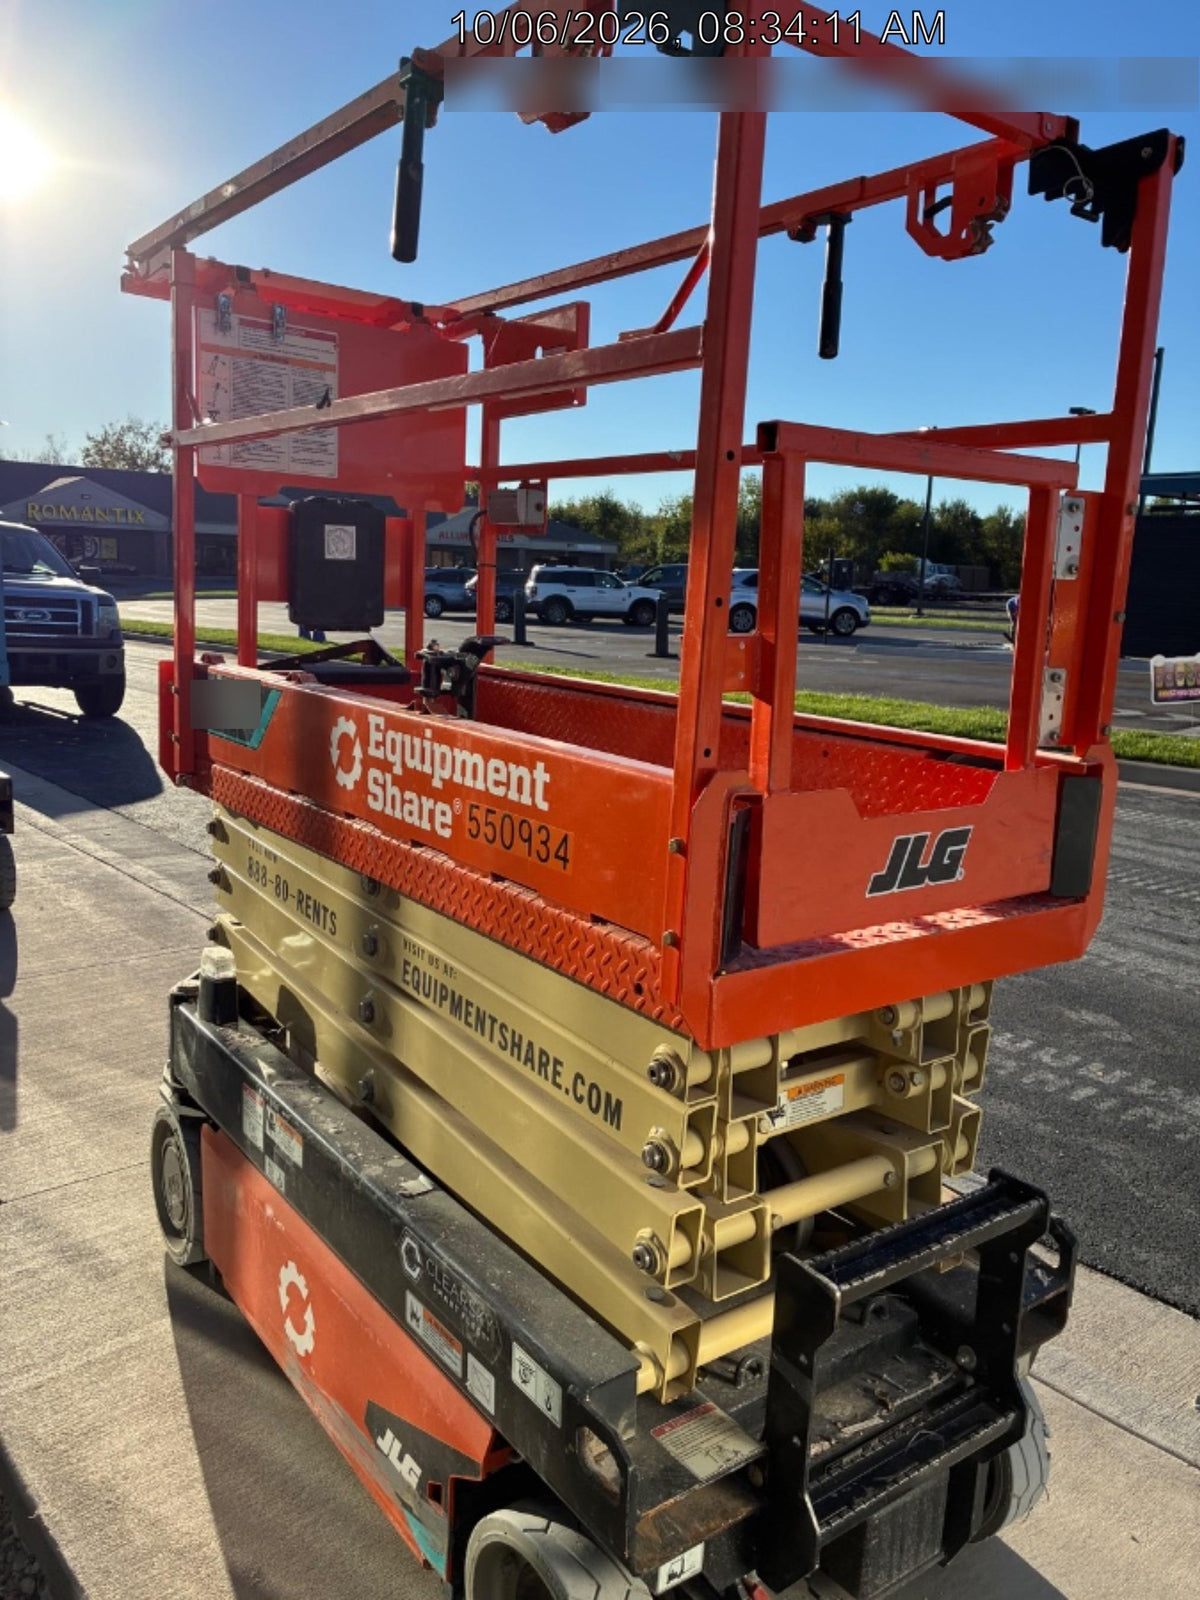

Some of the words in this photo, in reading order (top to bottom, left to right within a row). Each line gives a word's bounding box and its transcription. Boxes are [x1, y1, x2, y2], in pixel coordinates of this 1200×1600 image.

[26, 502, 145, 525] ROMANTIX
[367, 713, 550, 811] Equipment
[467, 803, 570, 871] 550934
[865, 824, 975, 898] JLG
[247, 855, 337, 936] 888-80-RENTS
[402, 937, 425, 962] VISIT
[428, 954, 440, 972] US
[401, 958, 624, 1132] EQUIPMENTSHARE.COM
[376, 1427, 423, 1490] JLG
